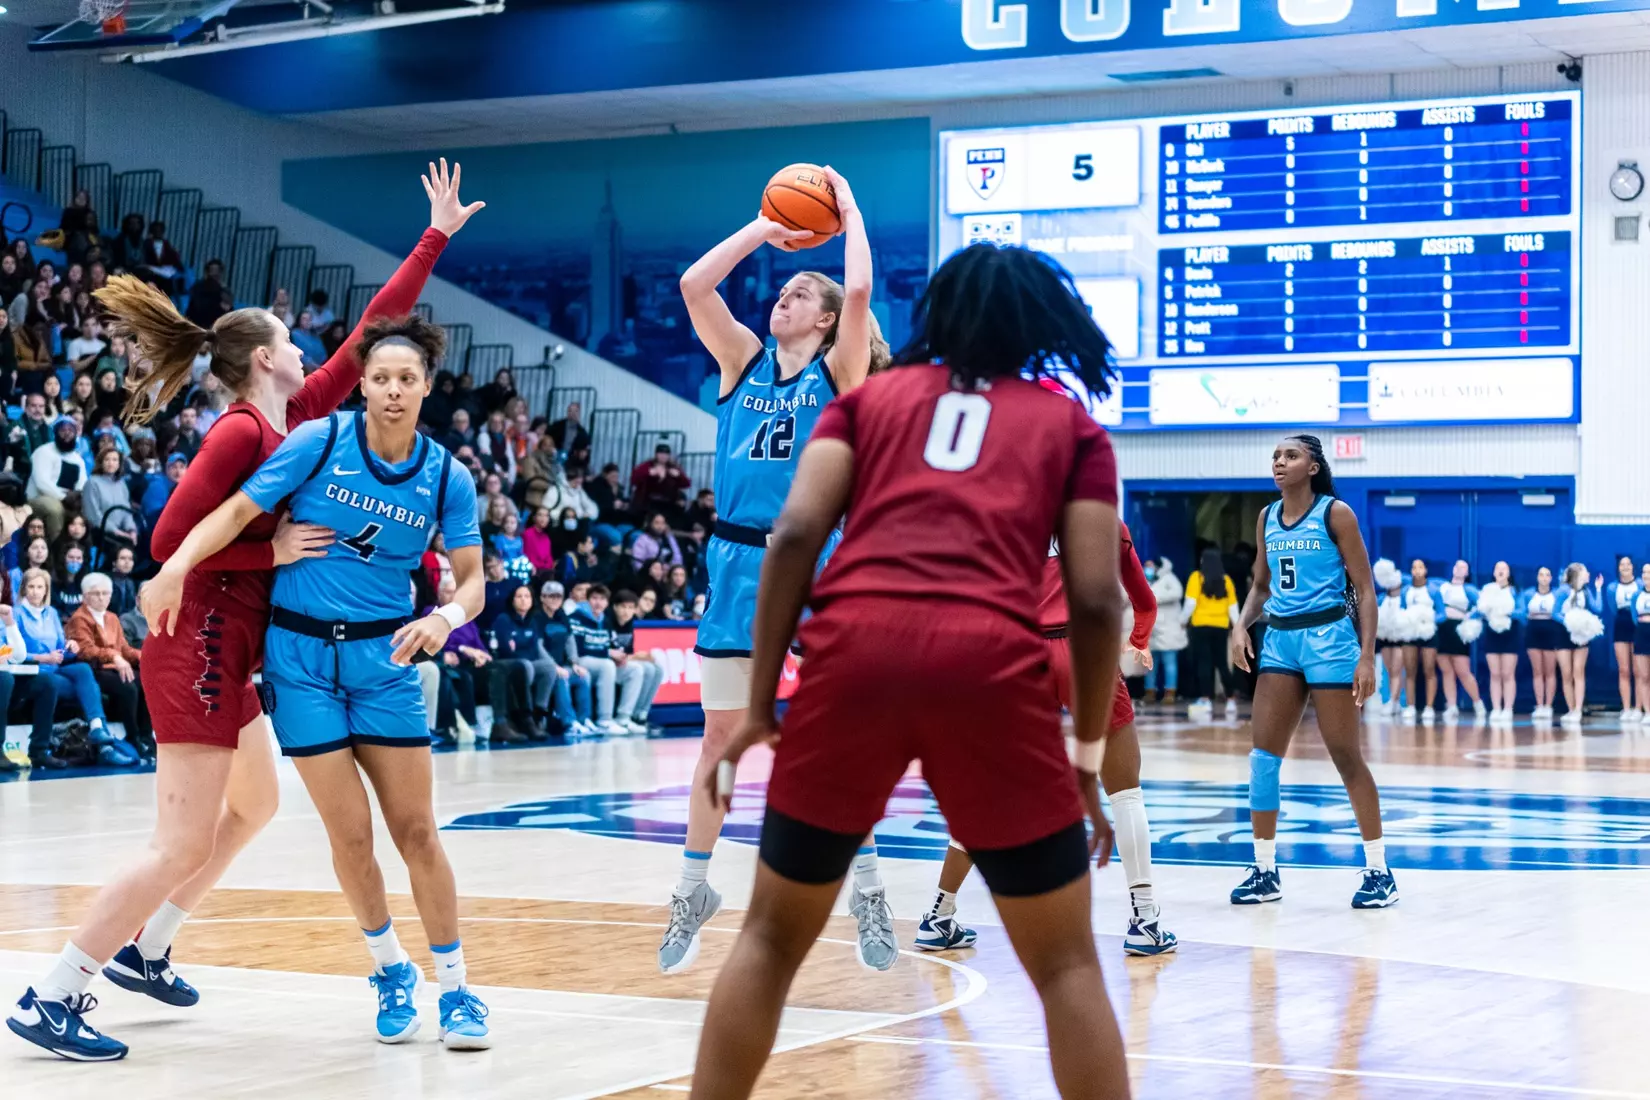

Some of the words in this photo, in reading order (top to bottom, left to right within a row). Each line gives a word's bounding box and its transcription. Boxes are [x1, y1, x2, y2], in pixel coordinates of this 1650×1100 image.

[1185, 122, 1231, 140] PLAYER
[1267, 117, 1314, 135] POINTS
[1332, 111, 1397, 131] REBOUNDS
[1422, 106, 1475, 125] ASSISTS
[1505, 102, 1545, 120] FOULS
[1286, 136, 1295, 151] 5
[1360, 131, 1367, 147] 1
[1444, 126, 1453, 141] 0
[980, 167, 995, 190] P
[1072, 154, 1094, 181] 5
[1359, 205, 1367, 220] 1
[1185, 246, 1229, 264] PLAYER
[1267, 244, 1313, 262] POINTS
[1331, 241, 1396, 260] REBOUNDS
[1421, 236, 1475, 256] ASSISTS
[1504, 233, 1545, 252] FOULS
[1285, 263, 1294, 278] 2
[1359, 260, 1367, 275] 2
[1444, 256, 1451, 271] 1
[1359, 314, 1366, 330] 1
[1443, 312, 1451, 328] 1
[743, 393, 818, 414] COLUMBIA
[749, 414, 796, 461] 12
[923, 391, 992, 472] 0
[1336, 436, 1362, 457] EXIT
[325, 483, 427, 530] COLUMBIA
[338, 521, 384, 563] 4
[1265, 540, 1321, 553] OLUMBIA
[1279, 556, 1297, 592] 5
